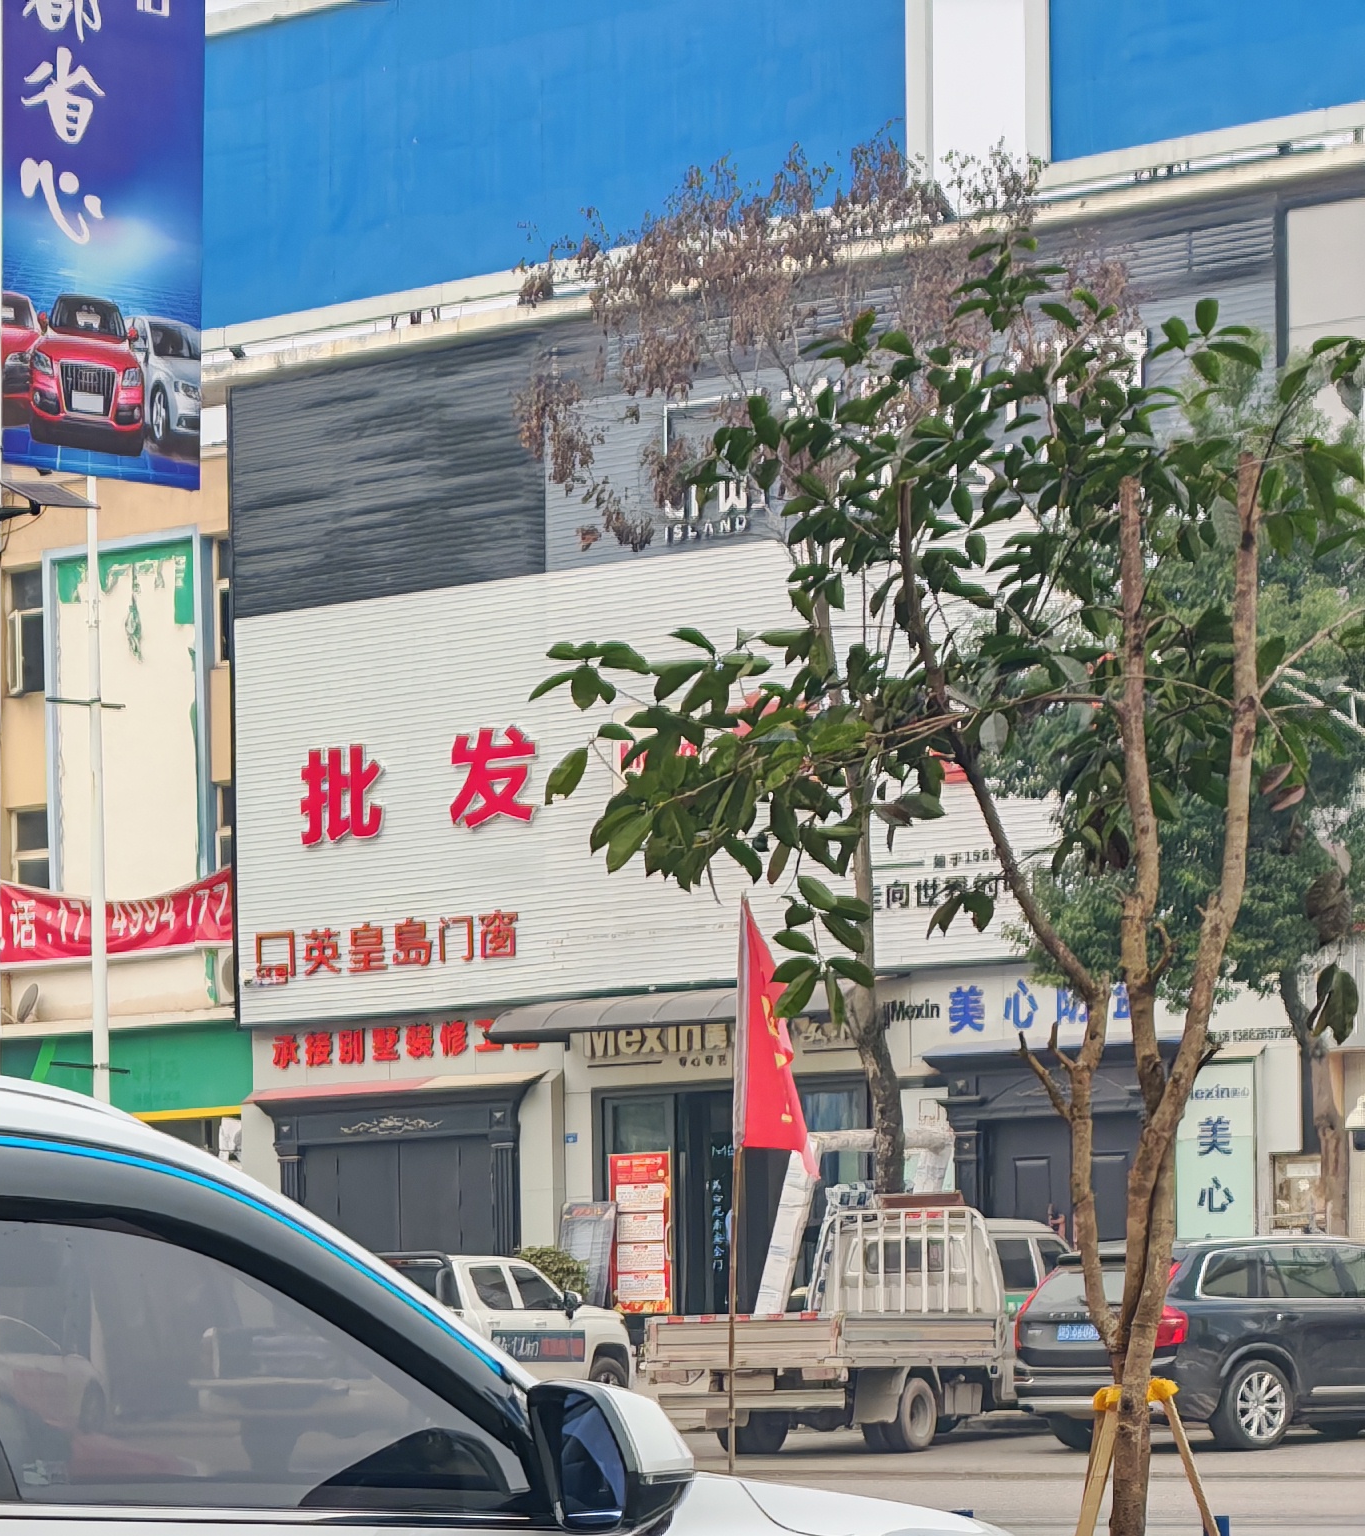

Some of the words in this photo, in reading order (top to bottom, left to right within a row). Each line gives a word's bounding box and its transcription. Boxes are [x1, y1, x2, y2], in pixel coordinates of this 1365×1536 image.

[299, 724, 540, 847] 批发
[301, 908, 519, 977] 英皇岛门窗
[272, 1018, 541, 1070] 承接别墅装修工
[582, 1024, 703, 1059] Mexin
[1197, 1115, 1235, 1213] 美心
